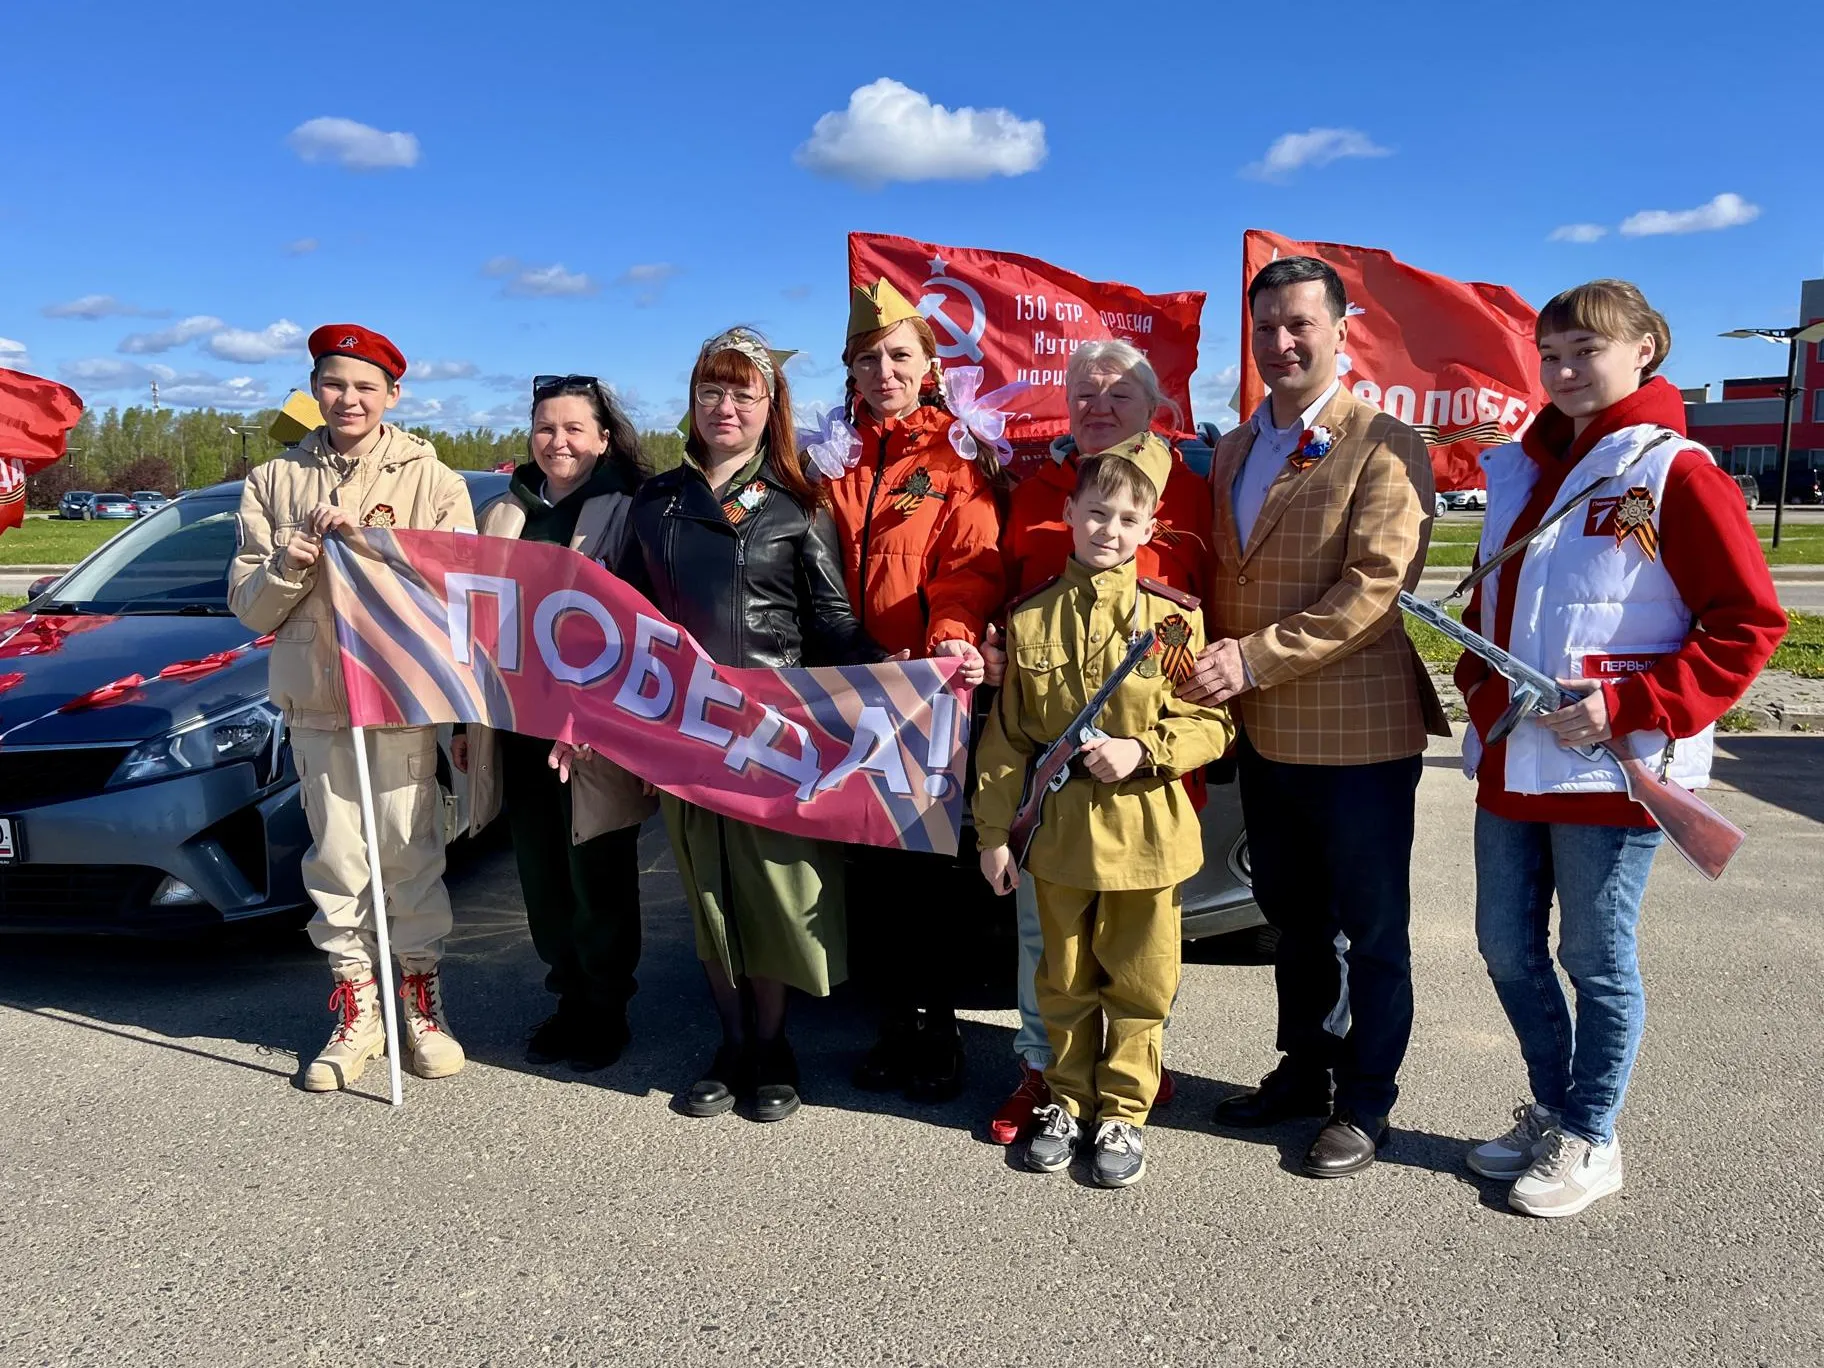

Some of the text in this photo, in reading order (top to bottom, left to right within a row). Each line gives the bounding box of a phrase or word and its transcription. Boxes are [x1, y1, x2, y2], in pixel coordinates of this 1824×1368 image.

[1015, 294, 1047, 321] 150
[1352, 380, 1536, 442] 80 ПОБЕ
[444, 571, 957, 802] ПОБЕДА!
